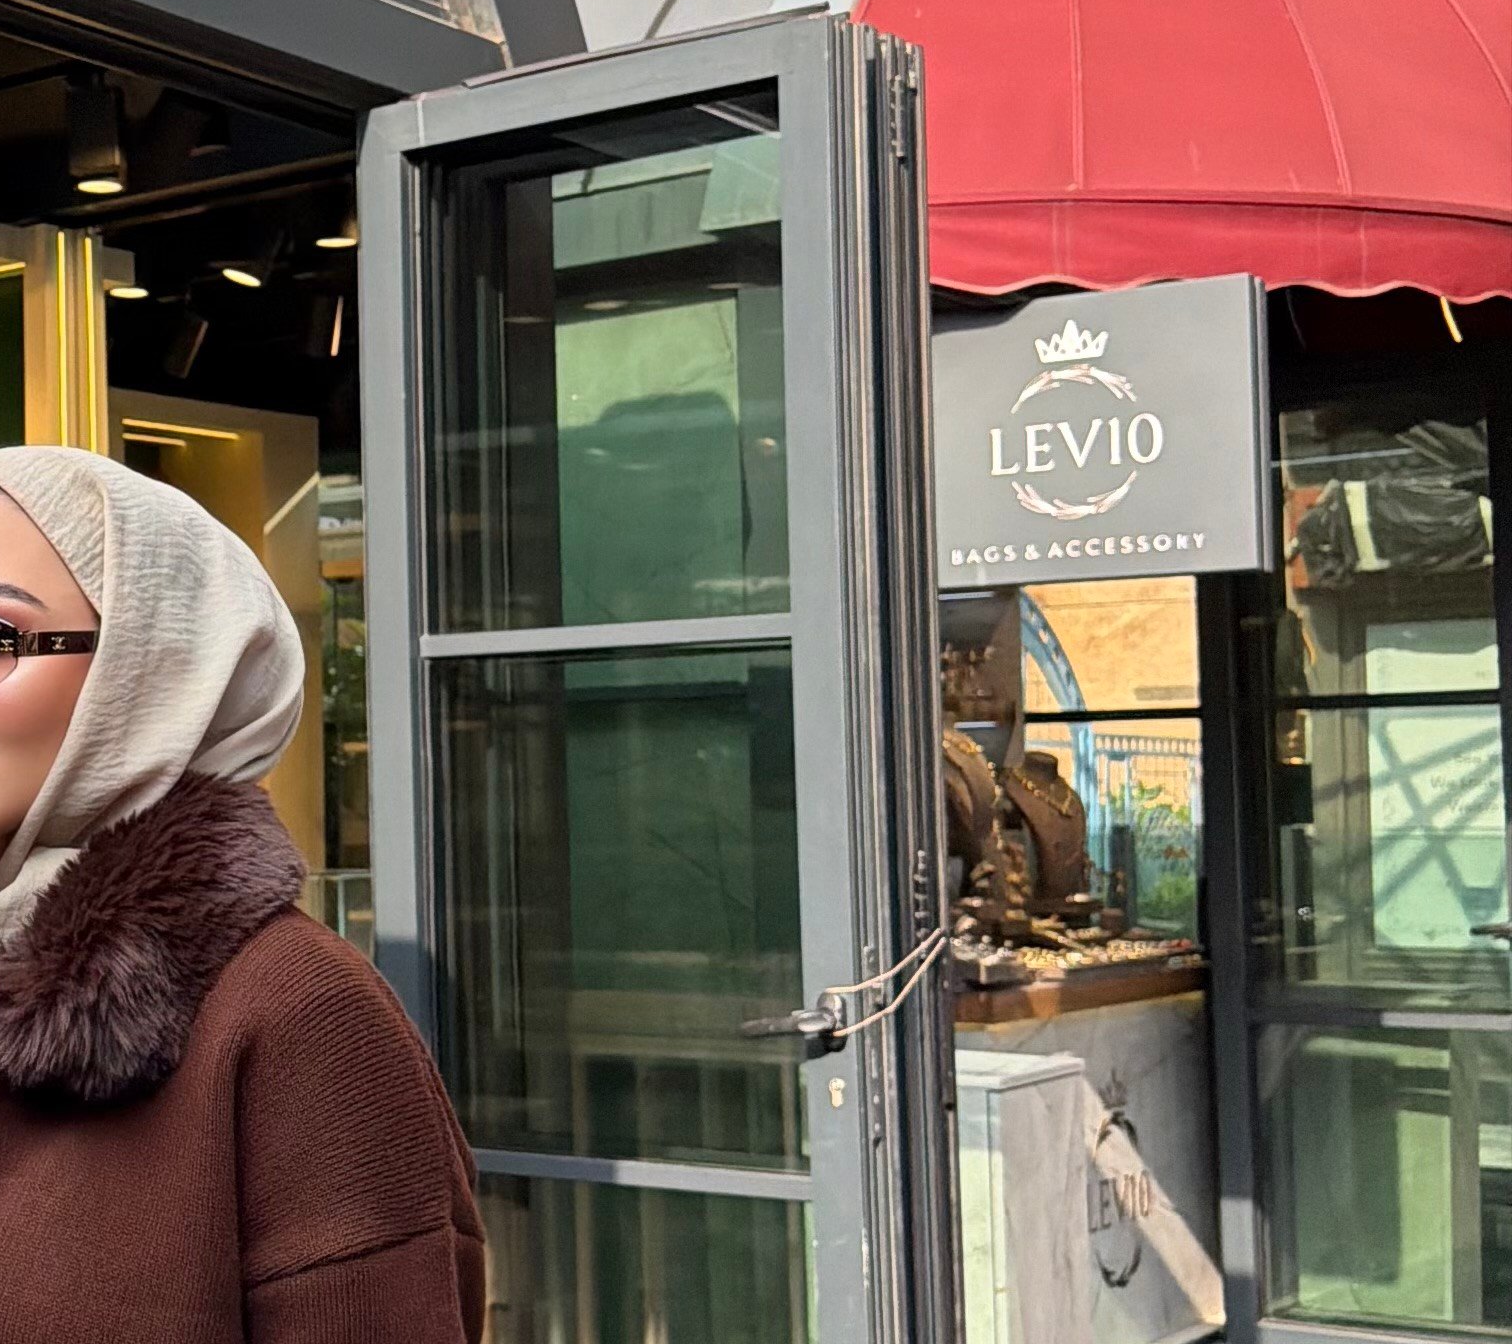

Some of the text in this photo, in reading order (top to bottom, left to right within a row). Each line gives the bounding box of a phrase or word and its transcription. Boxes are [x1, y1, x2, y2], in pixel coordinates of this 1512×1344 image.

[989, 411, 1164, 476] LEVIO
[950, 531, 1207, 567] BAGS & ACCESSORY
